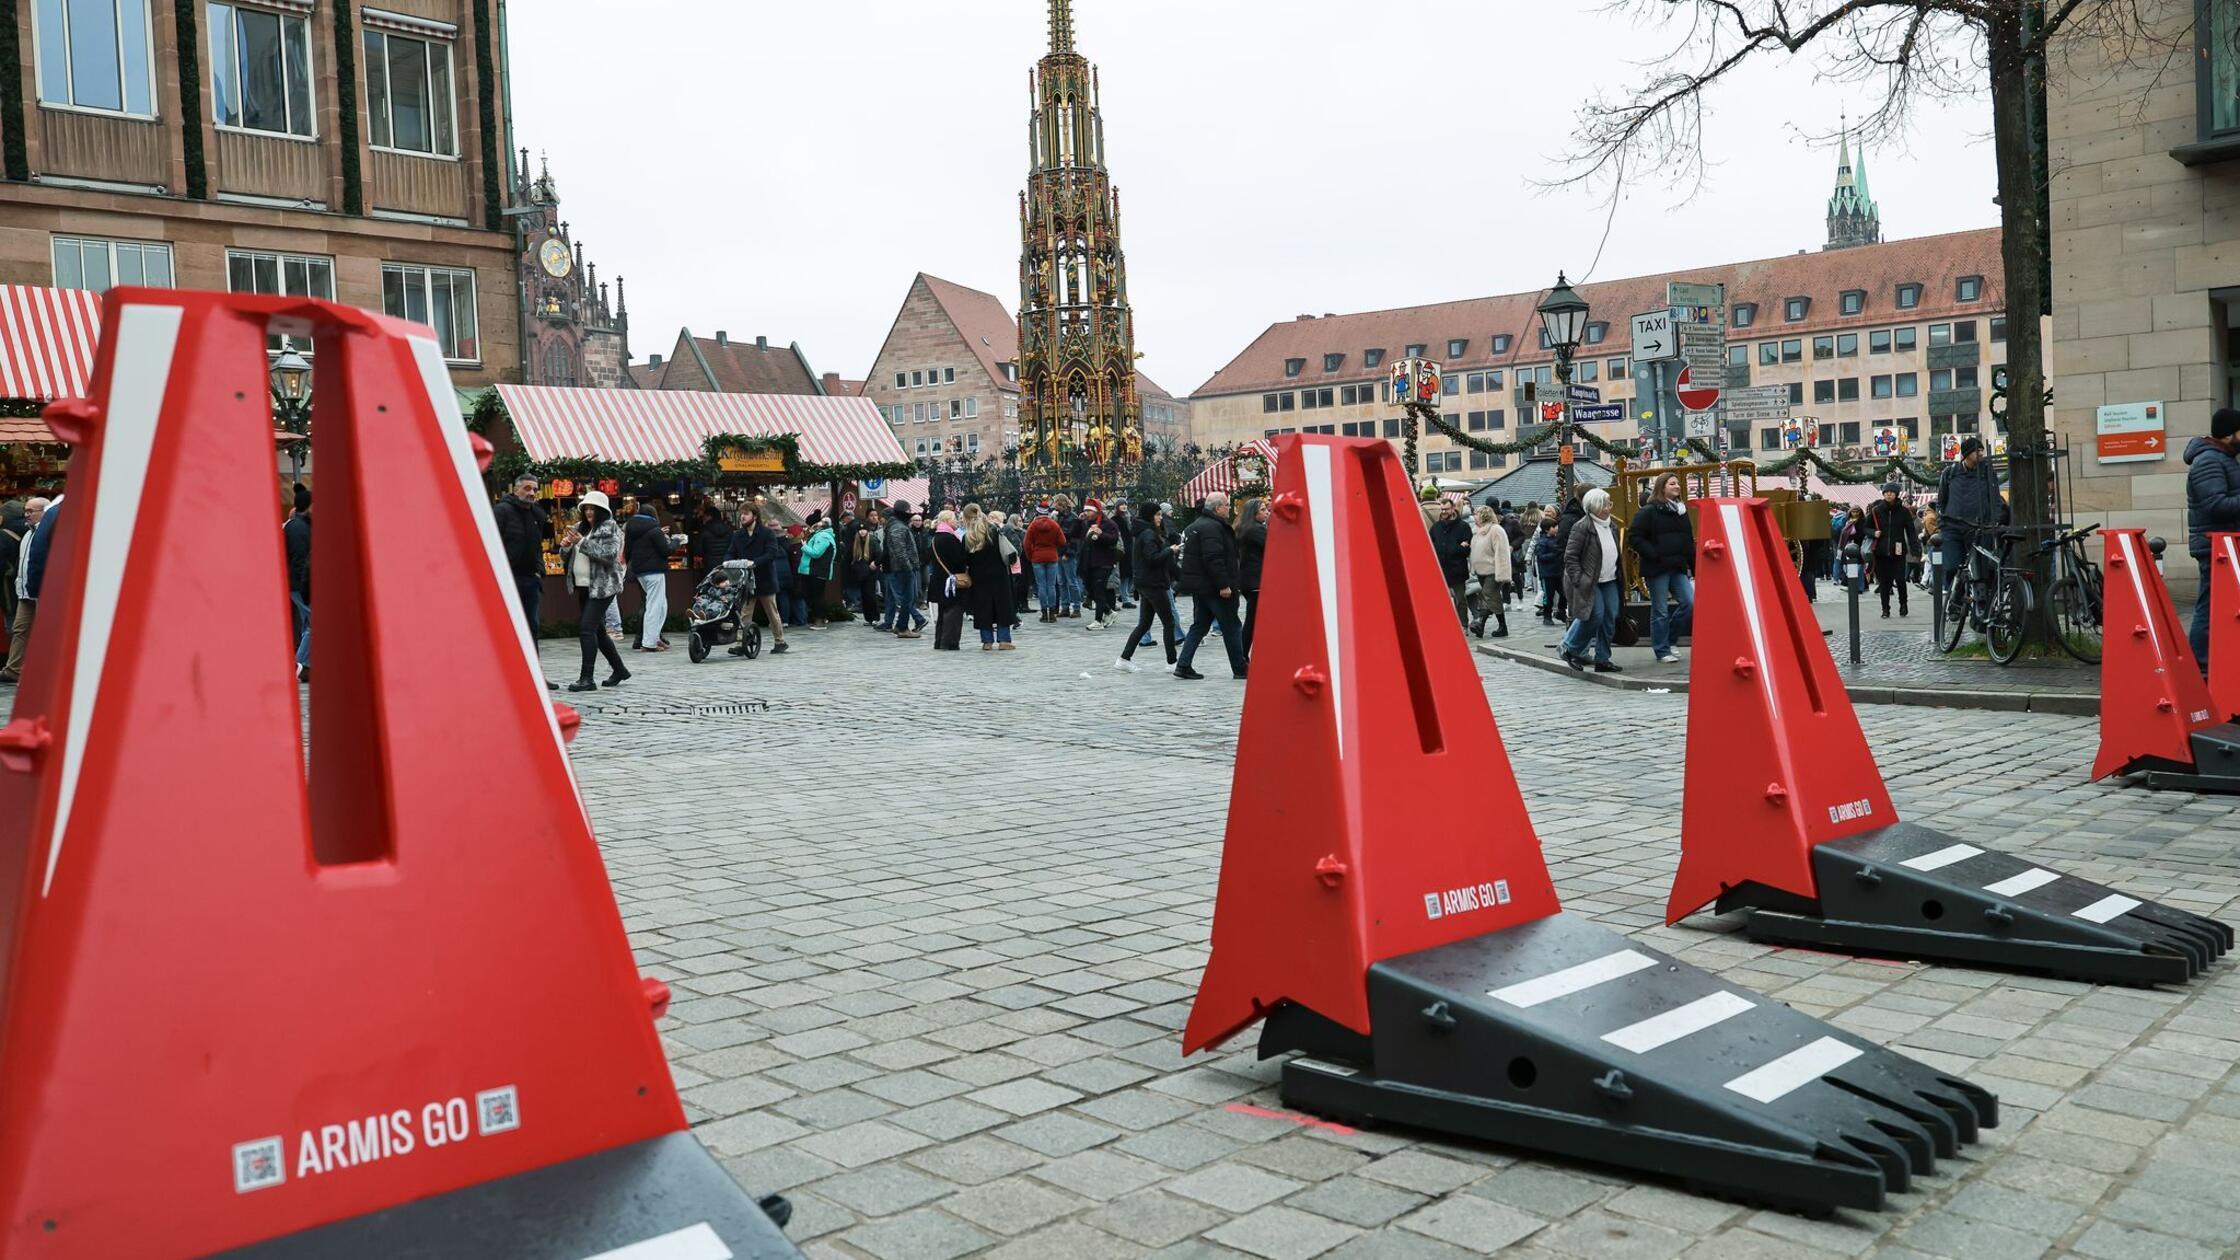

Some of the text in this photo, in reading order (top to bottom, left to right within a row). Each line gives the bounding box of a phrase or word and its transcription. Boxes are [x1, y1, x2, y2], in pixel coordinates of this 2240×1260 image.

[1638, 317, 1666, 332] TAXI
[1443, 883, 1495, 915] ARMIS GO
[297, 1097, 469, 1178] ARMIS GO
